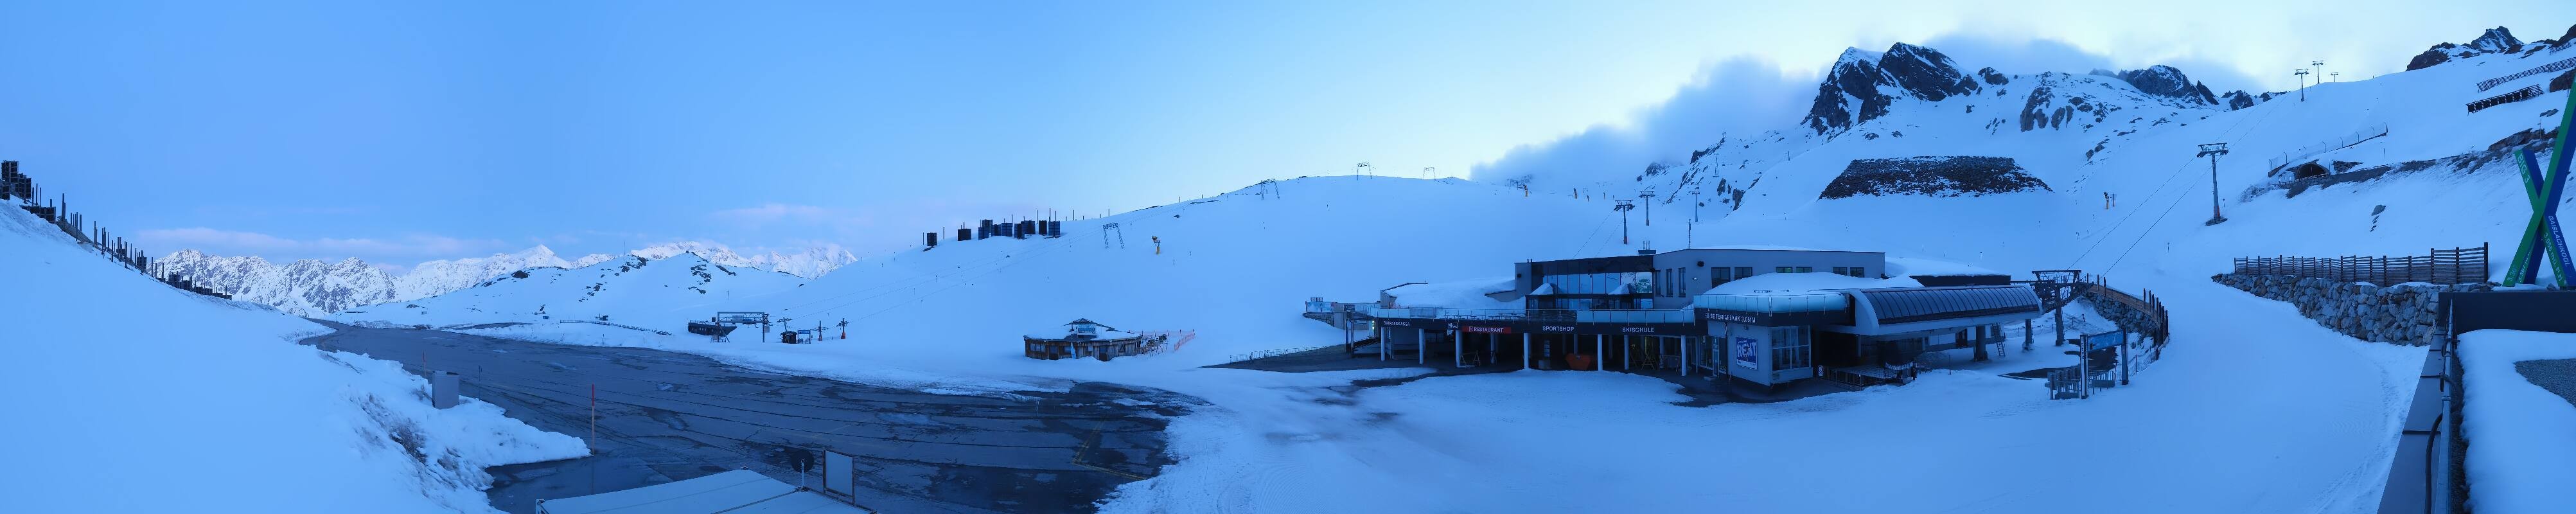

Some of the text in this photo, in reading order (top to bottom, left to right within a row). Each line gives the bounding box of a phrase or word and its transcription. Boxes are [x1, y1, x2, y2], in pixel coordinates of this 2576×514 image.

[2518, 153, 2530, 183] BIG 3
[2548, 215, 2570, 267] GAISLACHKOGL
